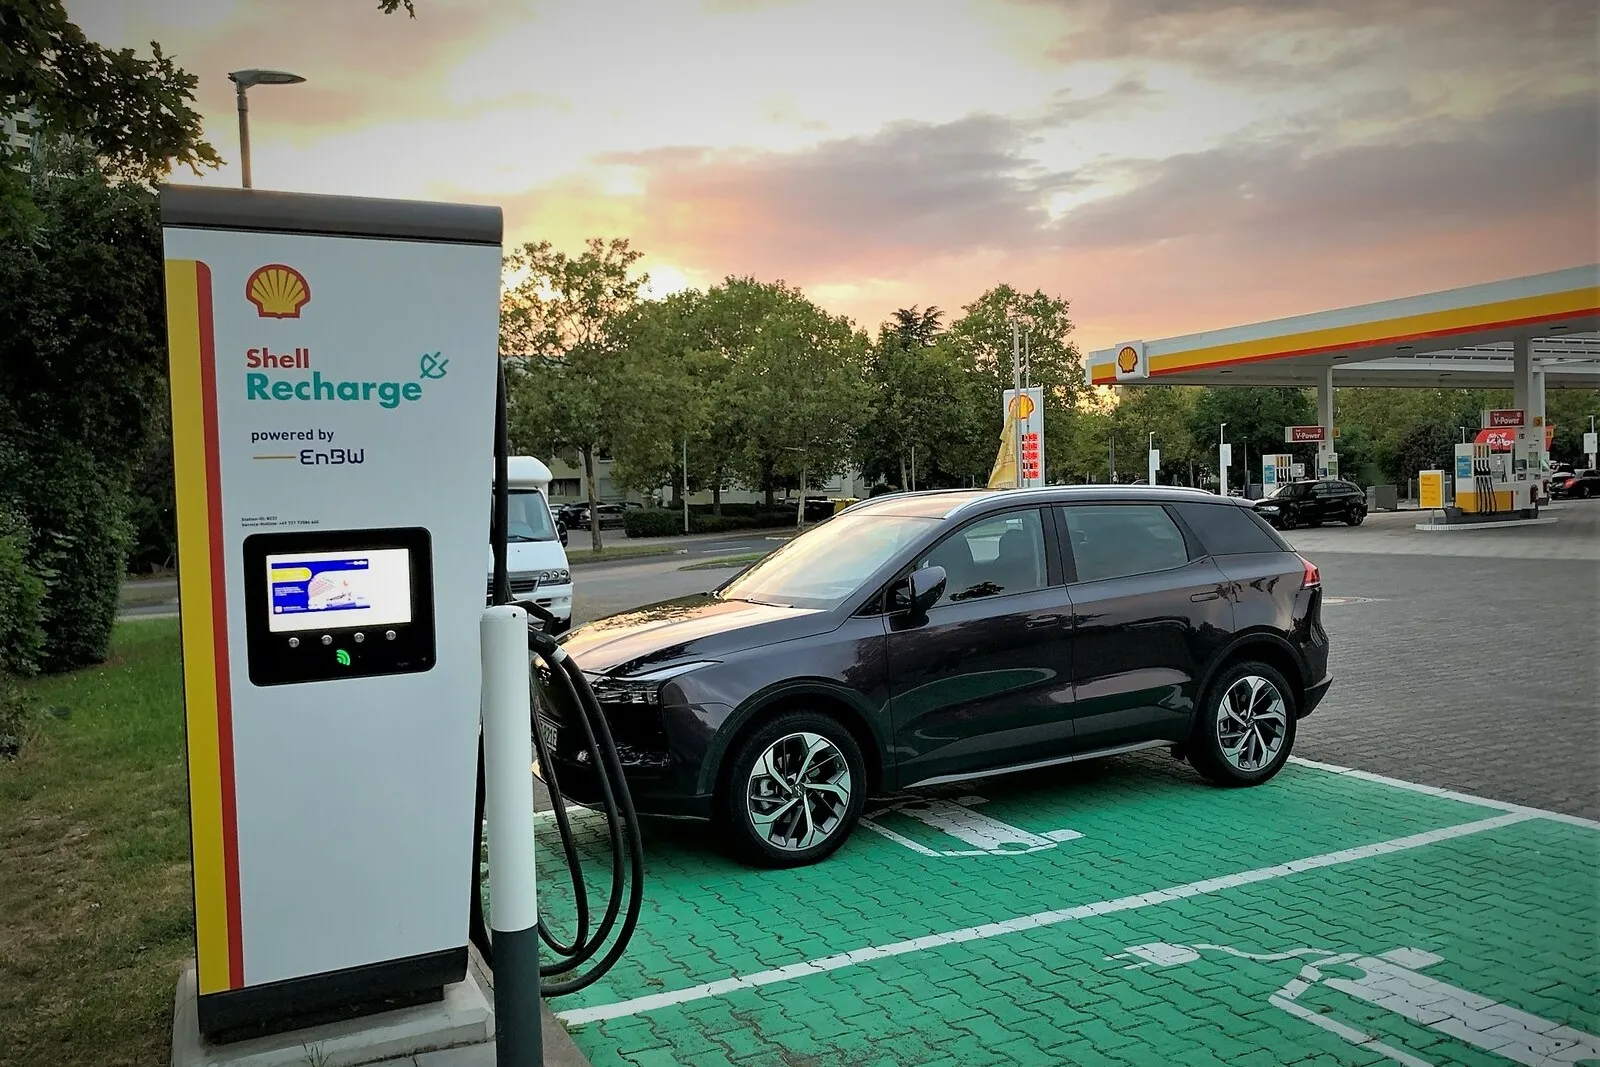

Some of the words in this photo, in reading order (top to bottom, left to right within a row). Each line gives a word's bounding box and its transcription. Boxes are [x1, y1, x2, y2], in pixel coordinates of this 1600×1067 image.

[246, 347, 310, 369] Shell
[246, 371, 423, 409] Recharge
[251, 429, 314, 443] powered
[318, 429, 335, 441] by
[300, 448, 365, 465] EnBW
